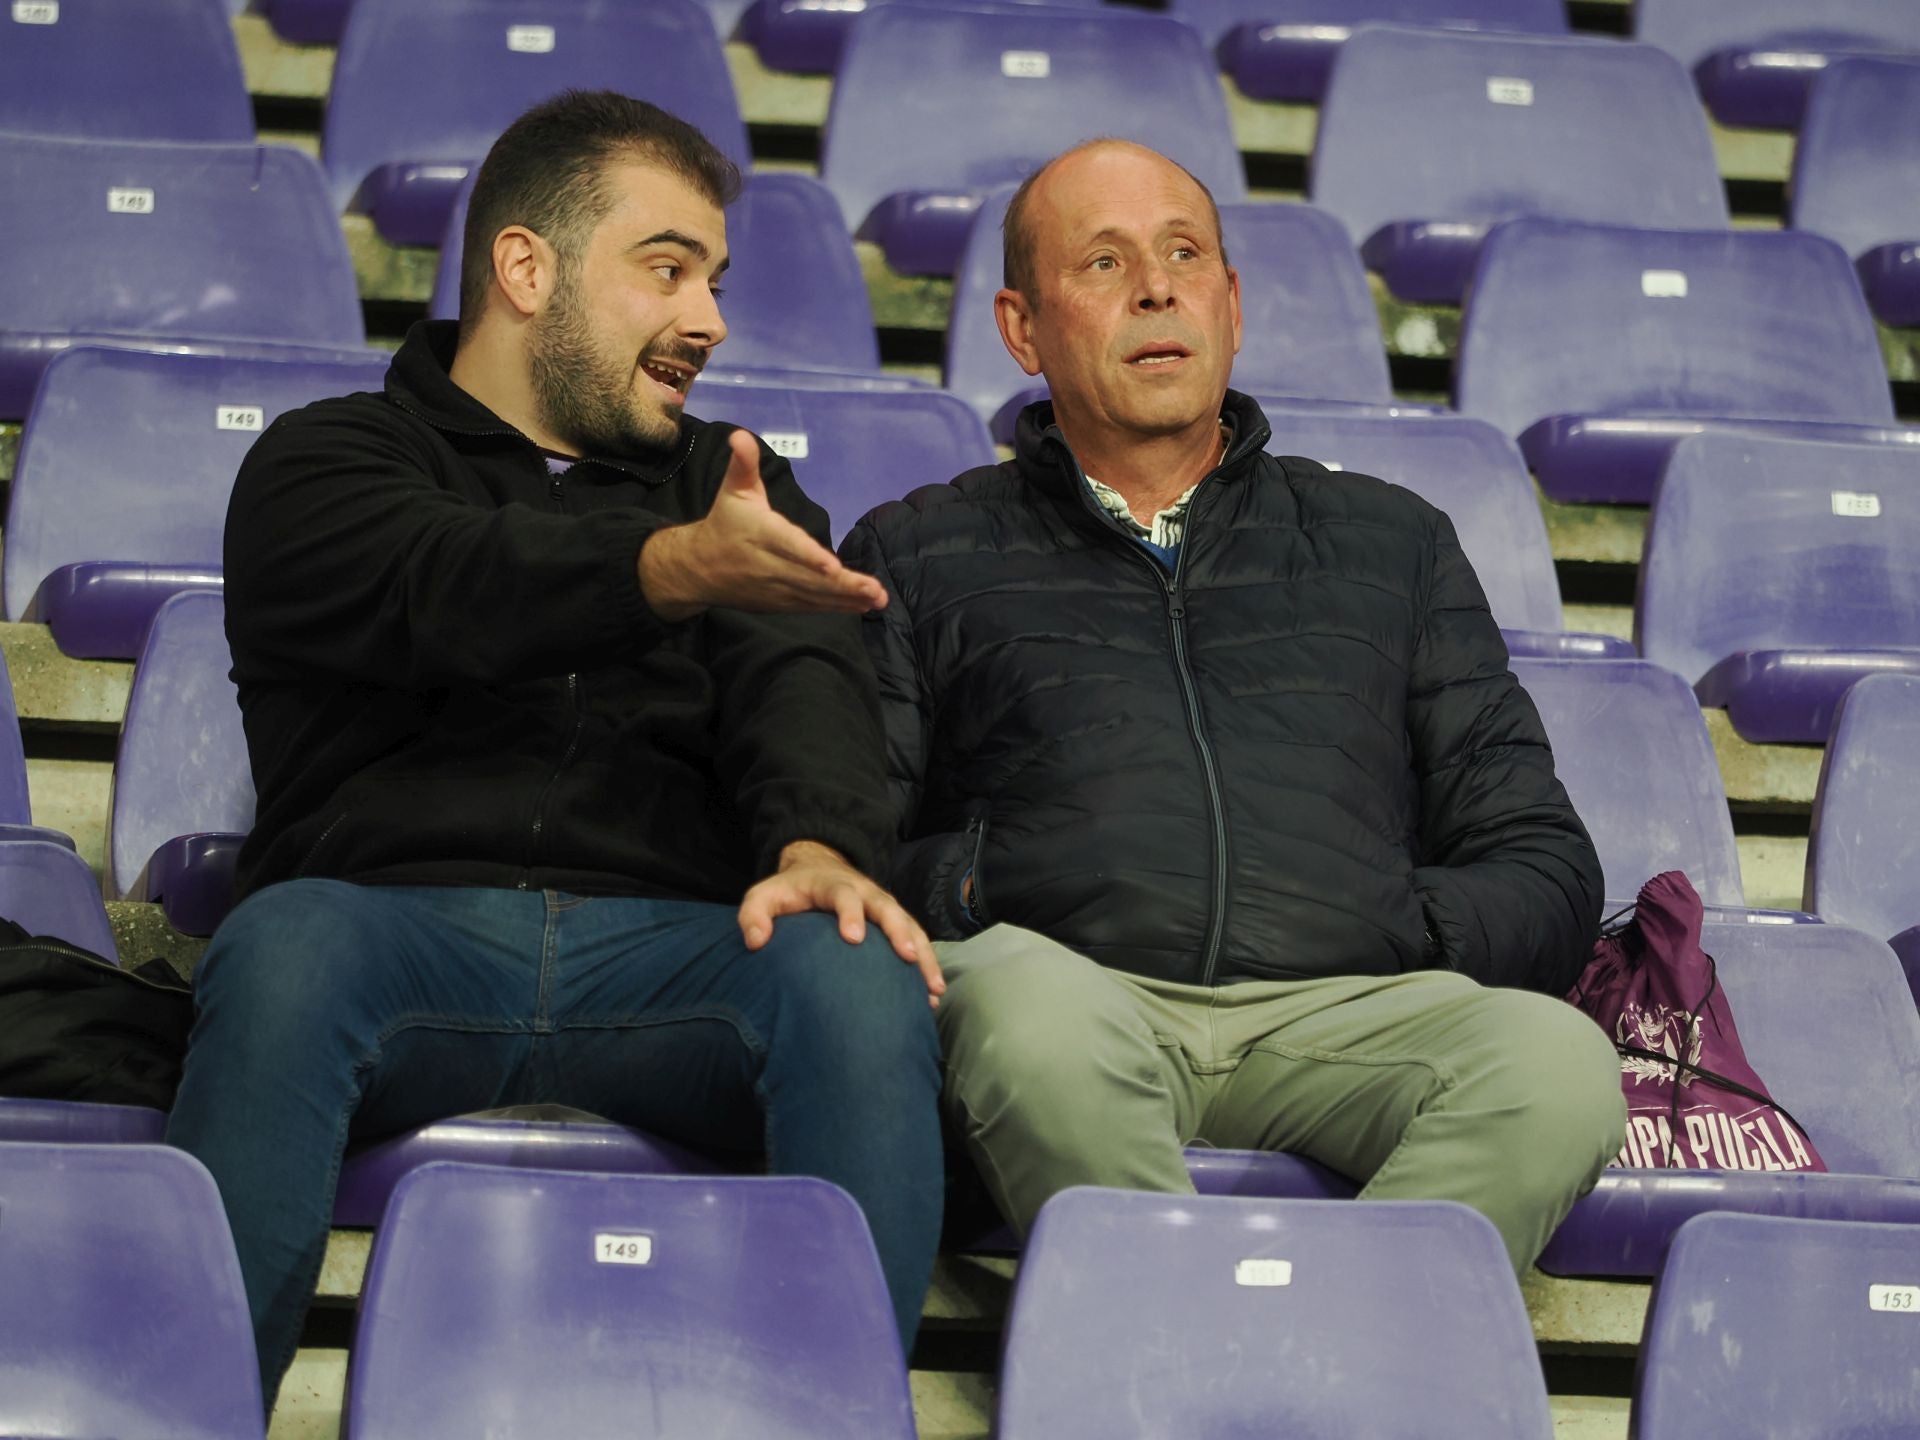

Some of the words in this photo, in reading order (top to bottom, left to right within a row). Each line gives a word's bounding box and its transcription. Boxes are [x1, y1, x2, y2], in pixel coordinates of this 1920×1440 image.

[117, 195, 146, 209] 149
[226, 412, 255, 426] 149
[771, 439, 798, 452] 151
[1606, 1116, 1687, 1168] UPA
[1685, 1111, 1812, 1171] PUCELA
[604, 1242, 638, 1258] 149
[1882, 1292, 1912, 1309] 153
